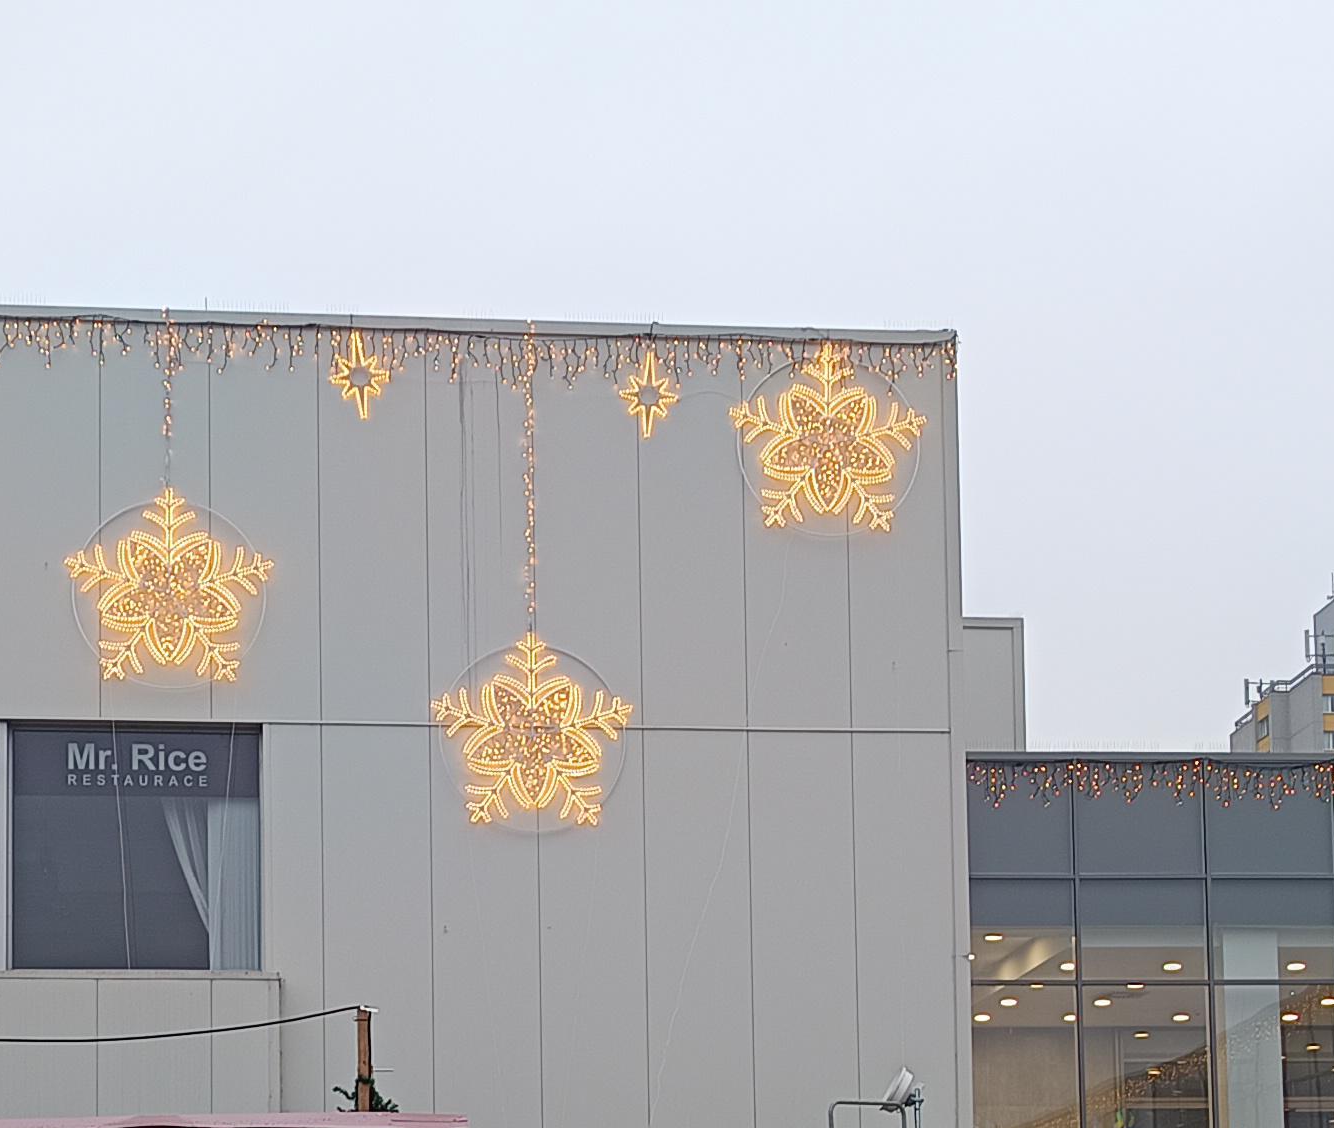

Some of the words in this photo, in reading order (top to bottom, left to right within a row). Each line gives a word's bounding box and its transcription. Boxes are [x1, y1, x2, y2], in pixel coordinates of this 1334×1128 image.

[67, 742, 118, 771] Mr.
[130, 743, 207, 772] Rice
[67, 774, 209, 788] RESTAURACE
